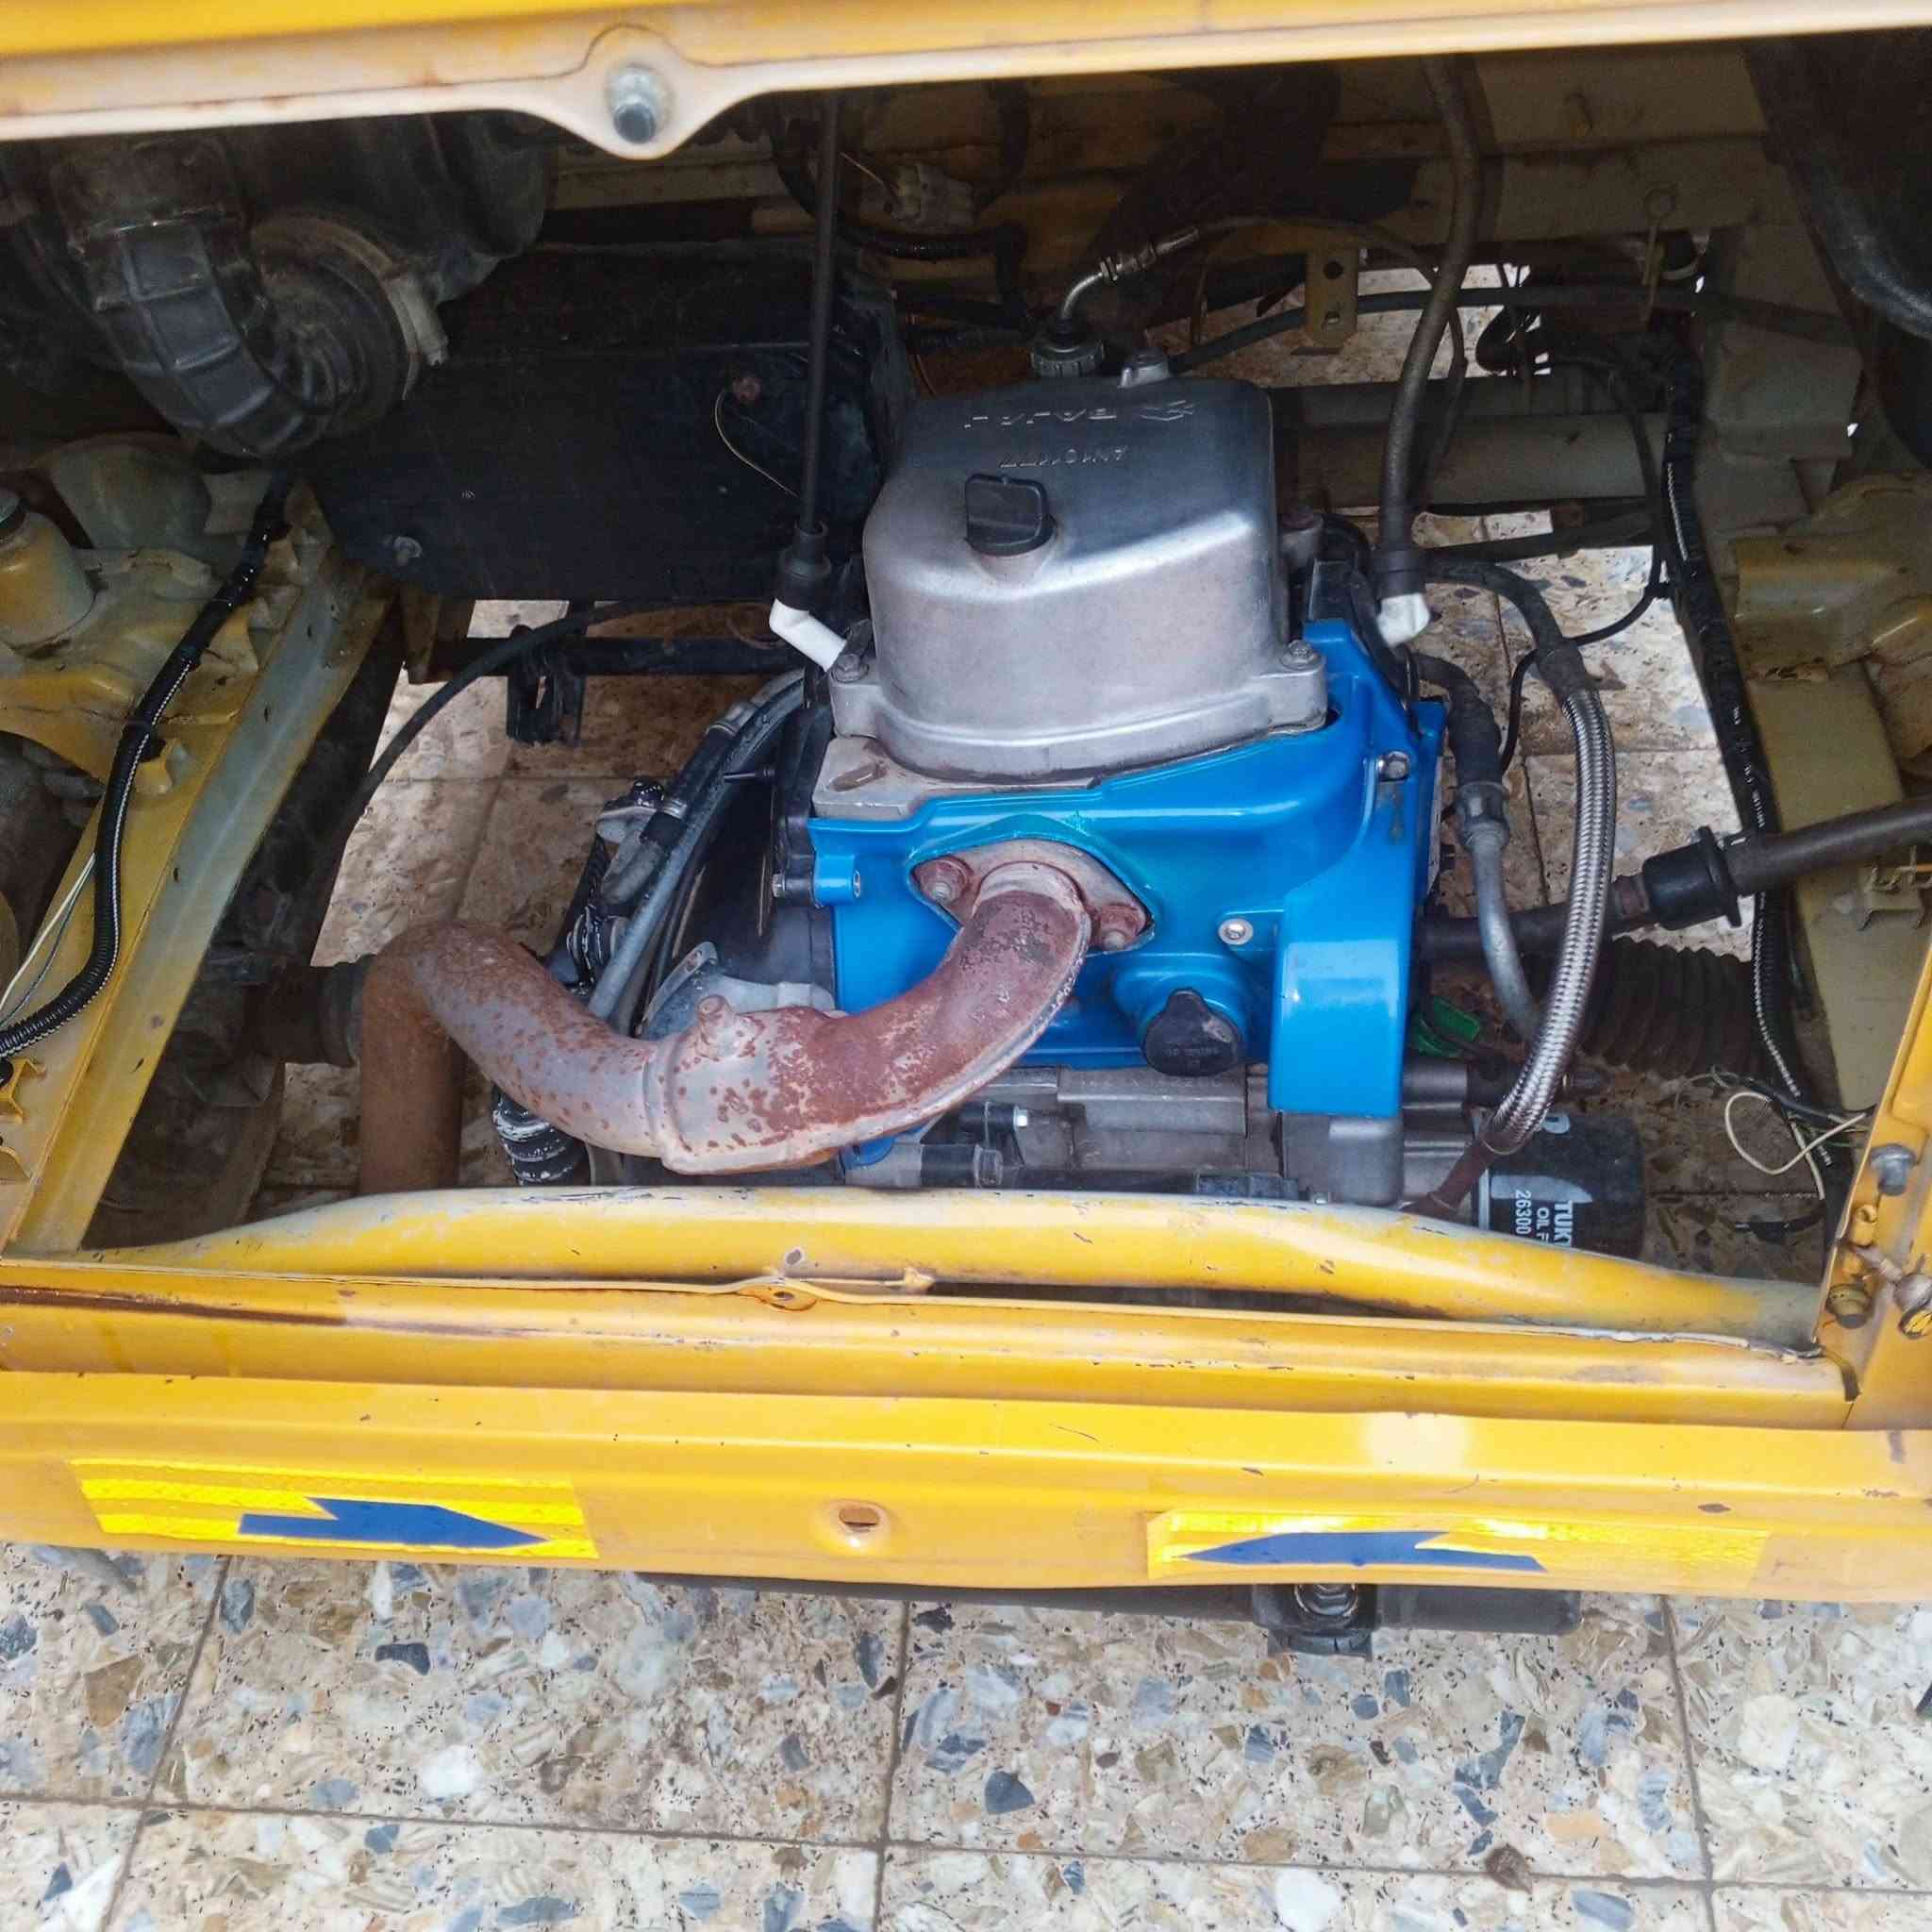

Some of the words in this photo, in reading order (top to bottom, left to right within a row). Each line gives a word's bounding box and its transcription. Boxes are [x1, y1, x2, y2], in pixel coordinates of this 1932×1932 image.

[963, 408, 1117, 429] BAJAJ
[1515, 1190, 1532, 1235] 26300
[1536, 1207, 1550, 1230] OIL
